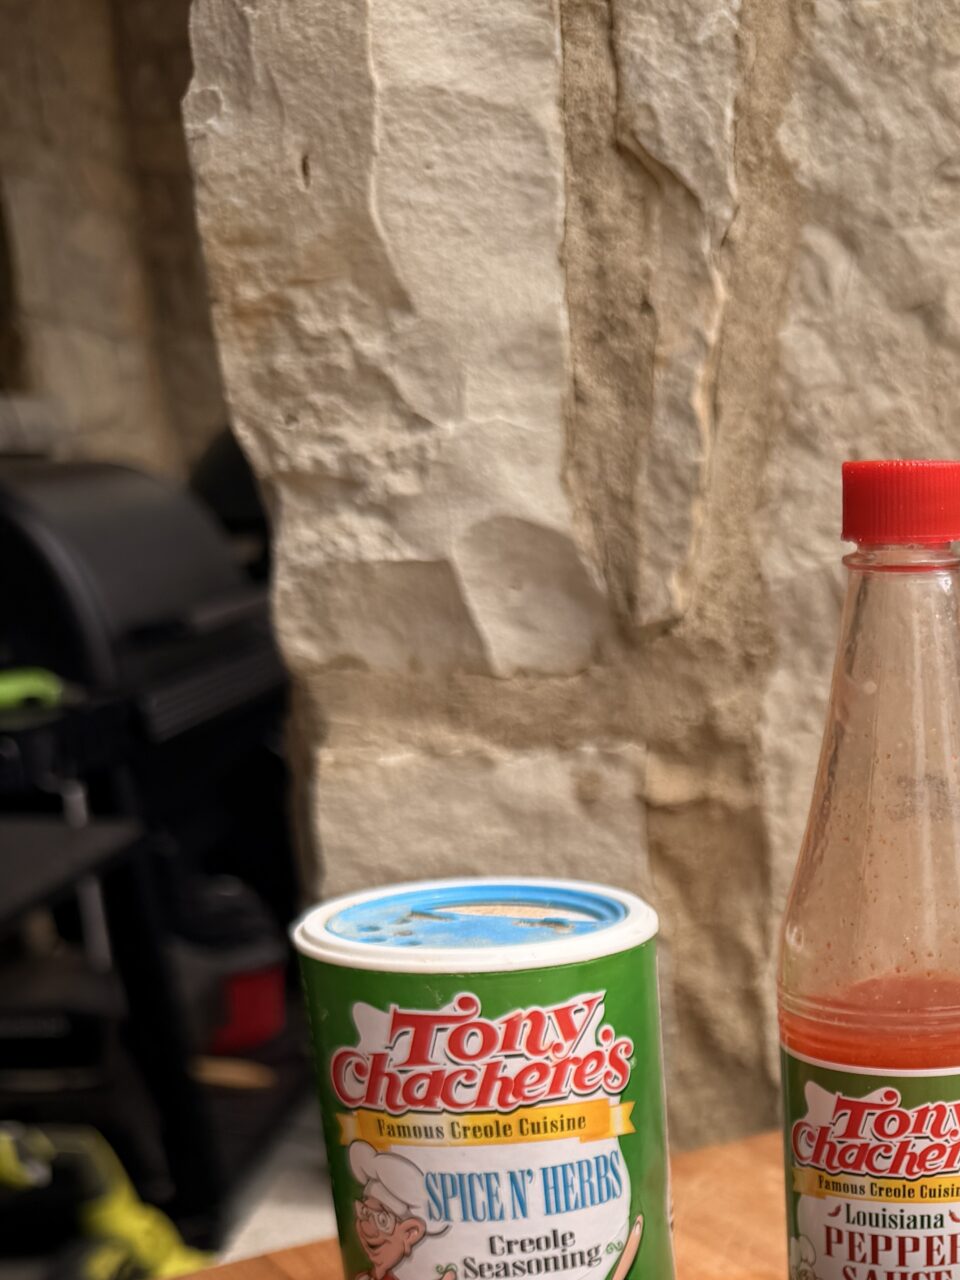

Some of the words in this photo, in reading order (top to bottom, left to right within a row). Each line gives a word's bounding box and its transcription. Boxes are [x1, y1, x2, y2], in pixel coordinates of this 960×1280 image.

[389, 995, 603, 1067] Tony
[332, 1028, 632, 1109] Chachere's
[377, 1118, 444, 1139] Famous
[450, 1119, 513, 1139] Creole
[519, 1114, 586, 1136] Cuisine
[425, 1171, 504, 1222] SPICE
[507, 1169, 534, 1219] N'
[540, 1150, 623, 1216] HERBS
[818, 1175, 866, 1196] Famous
[870, 1182, 915, 1199] Creole
[845, 1203, 945, 1230] Louisiana
[489, 1229, 576, 1256] Creole
[462, 1244, 602, 1280] Seasoning
